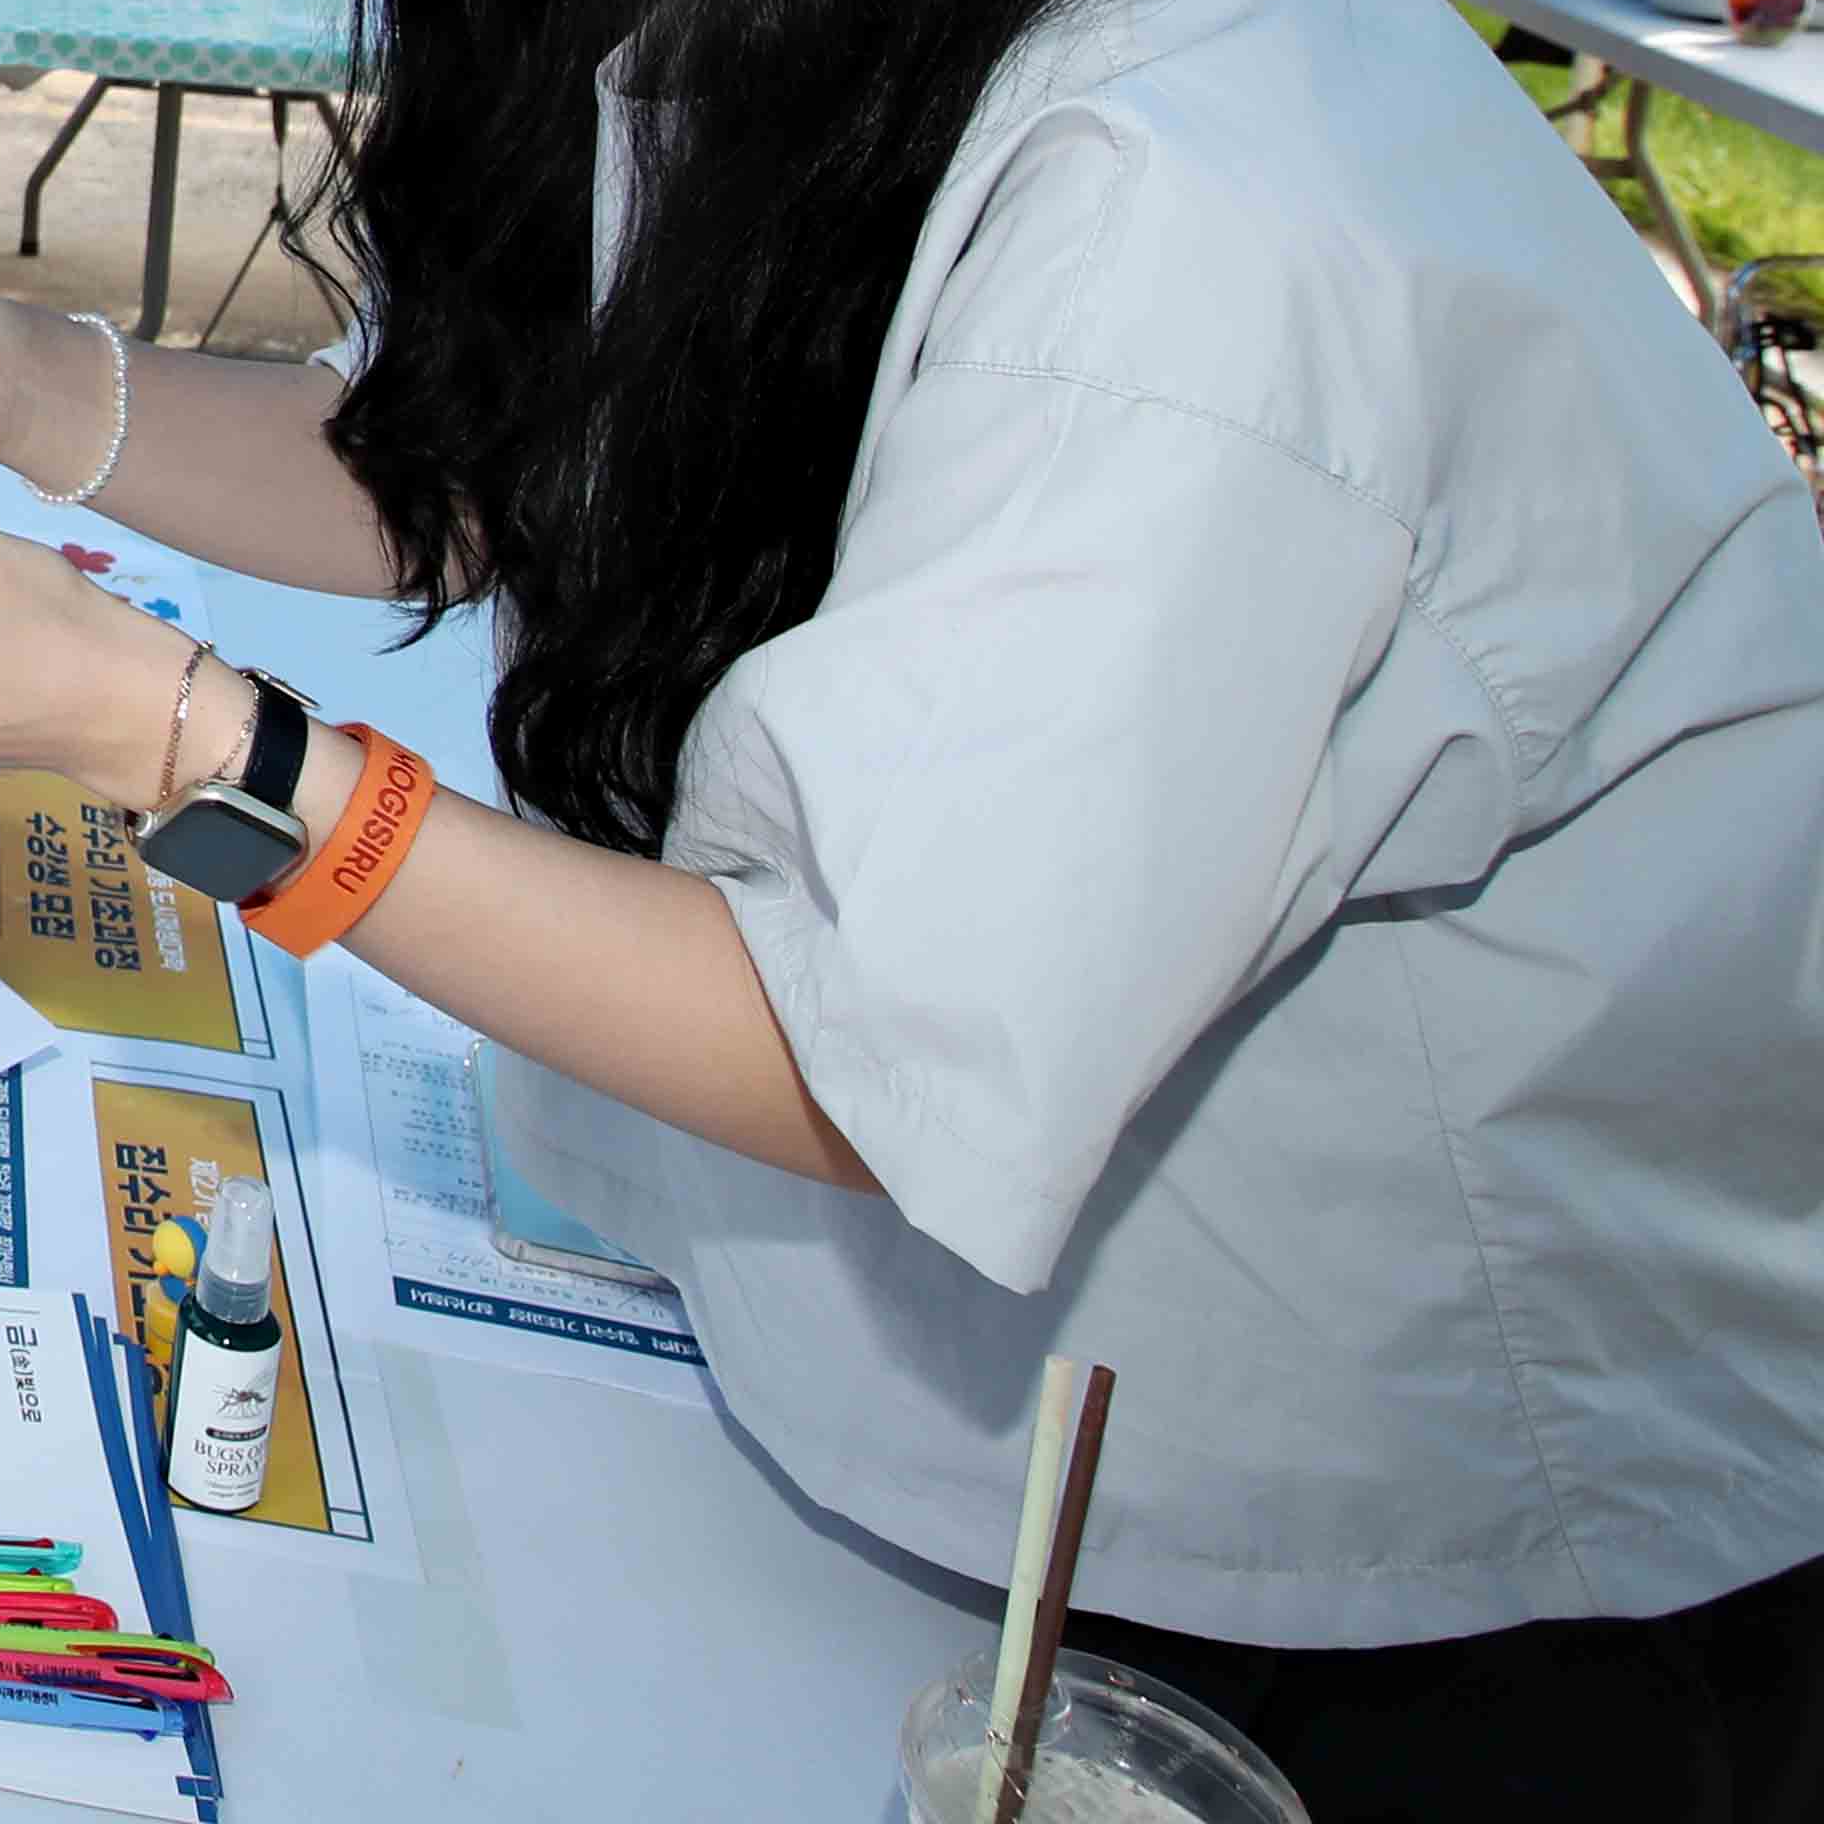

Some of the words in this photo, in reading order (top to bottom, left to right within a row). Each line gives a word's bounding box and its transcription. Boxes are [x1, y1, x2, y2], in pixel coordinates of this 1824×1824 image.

[25, 814, 70, 887] 수강생
[80, 804, 127, 871] 집수리
[30, 891, 75, 940] 모집
[87, 878, 140, 972] 기초과정
[194, 1439, 244, 1462] BUGS
[206, 1461, 260, 1476] SPRAY
